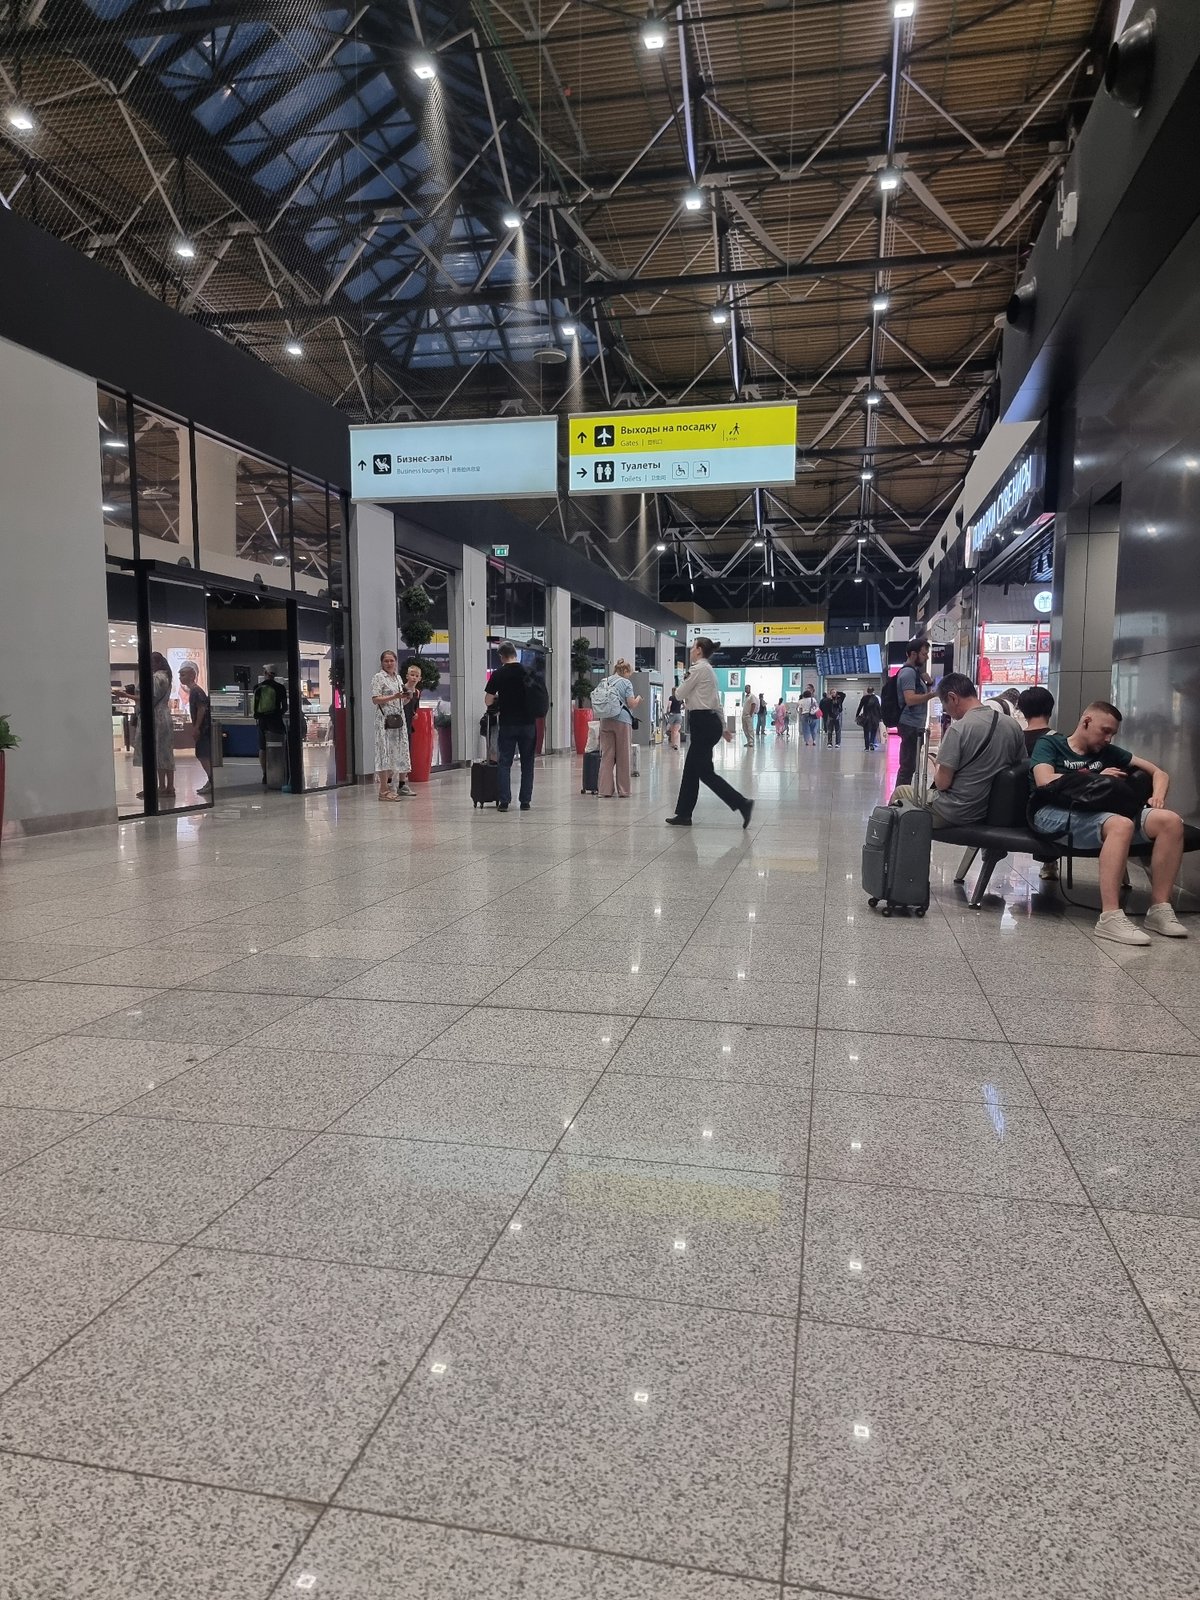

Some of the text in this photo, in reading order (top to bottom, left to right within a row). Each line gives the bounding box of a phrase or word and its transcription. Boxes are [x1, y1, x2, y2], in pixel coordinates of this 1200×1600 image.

[620, 425, 660, 435] Выходы
[676, 422, 717, 432] посадку
[397, 454, 453, 464] Бизнес-залы
[397, 466, 445, 475] Business lounges
[621, 461, 661, 472] Туалеты
